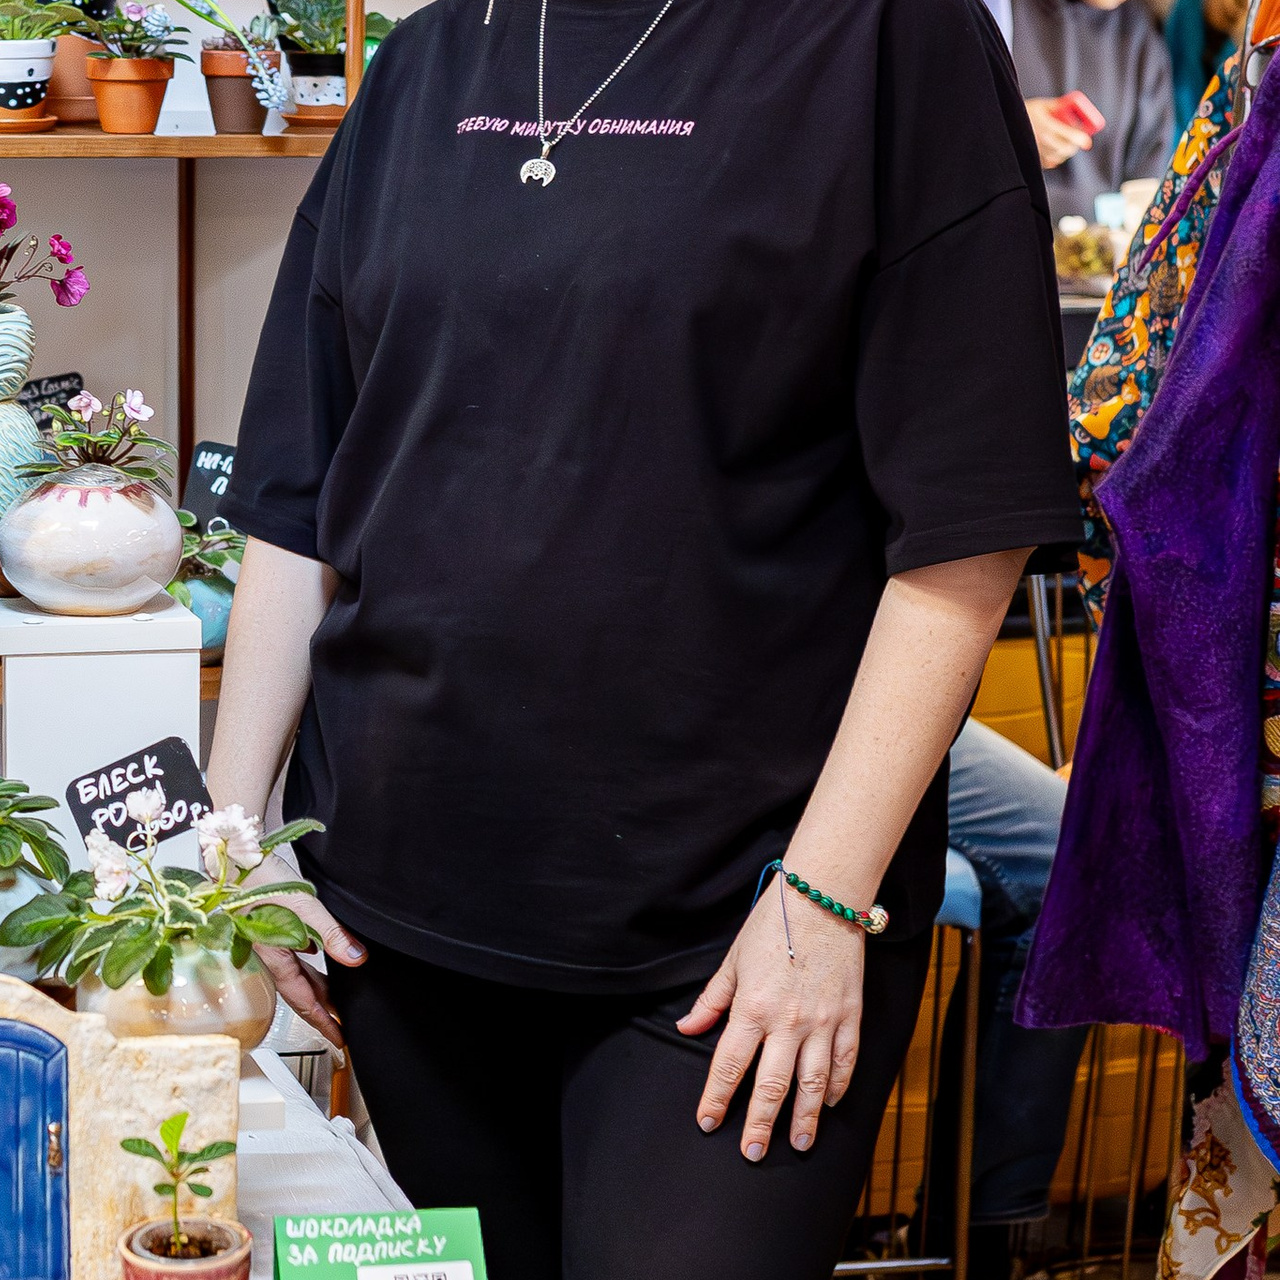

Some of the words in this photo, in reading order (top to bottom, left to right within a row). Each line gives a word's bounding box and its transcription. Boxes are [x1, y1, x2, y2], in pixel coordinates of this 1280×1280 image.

[588, 118, 695, 136] ОБНИМАНИЯ
[75, 754, 165, 805] БЛЕСК
[286, 1214, 422, 1240] ШОКОЛАДКА
[287, 1243, 319, 1267] ЗА
[327, 1234, 447, 1267] ПОДПИСКУ
